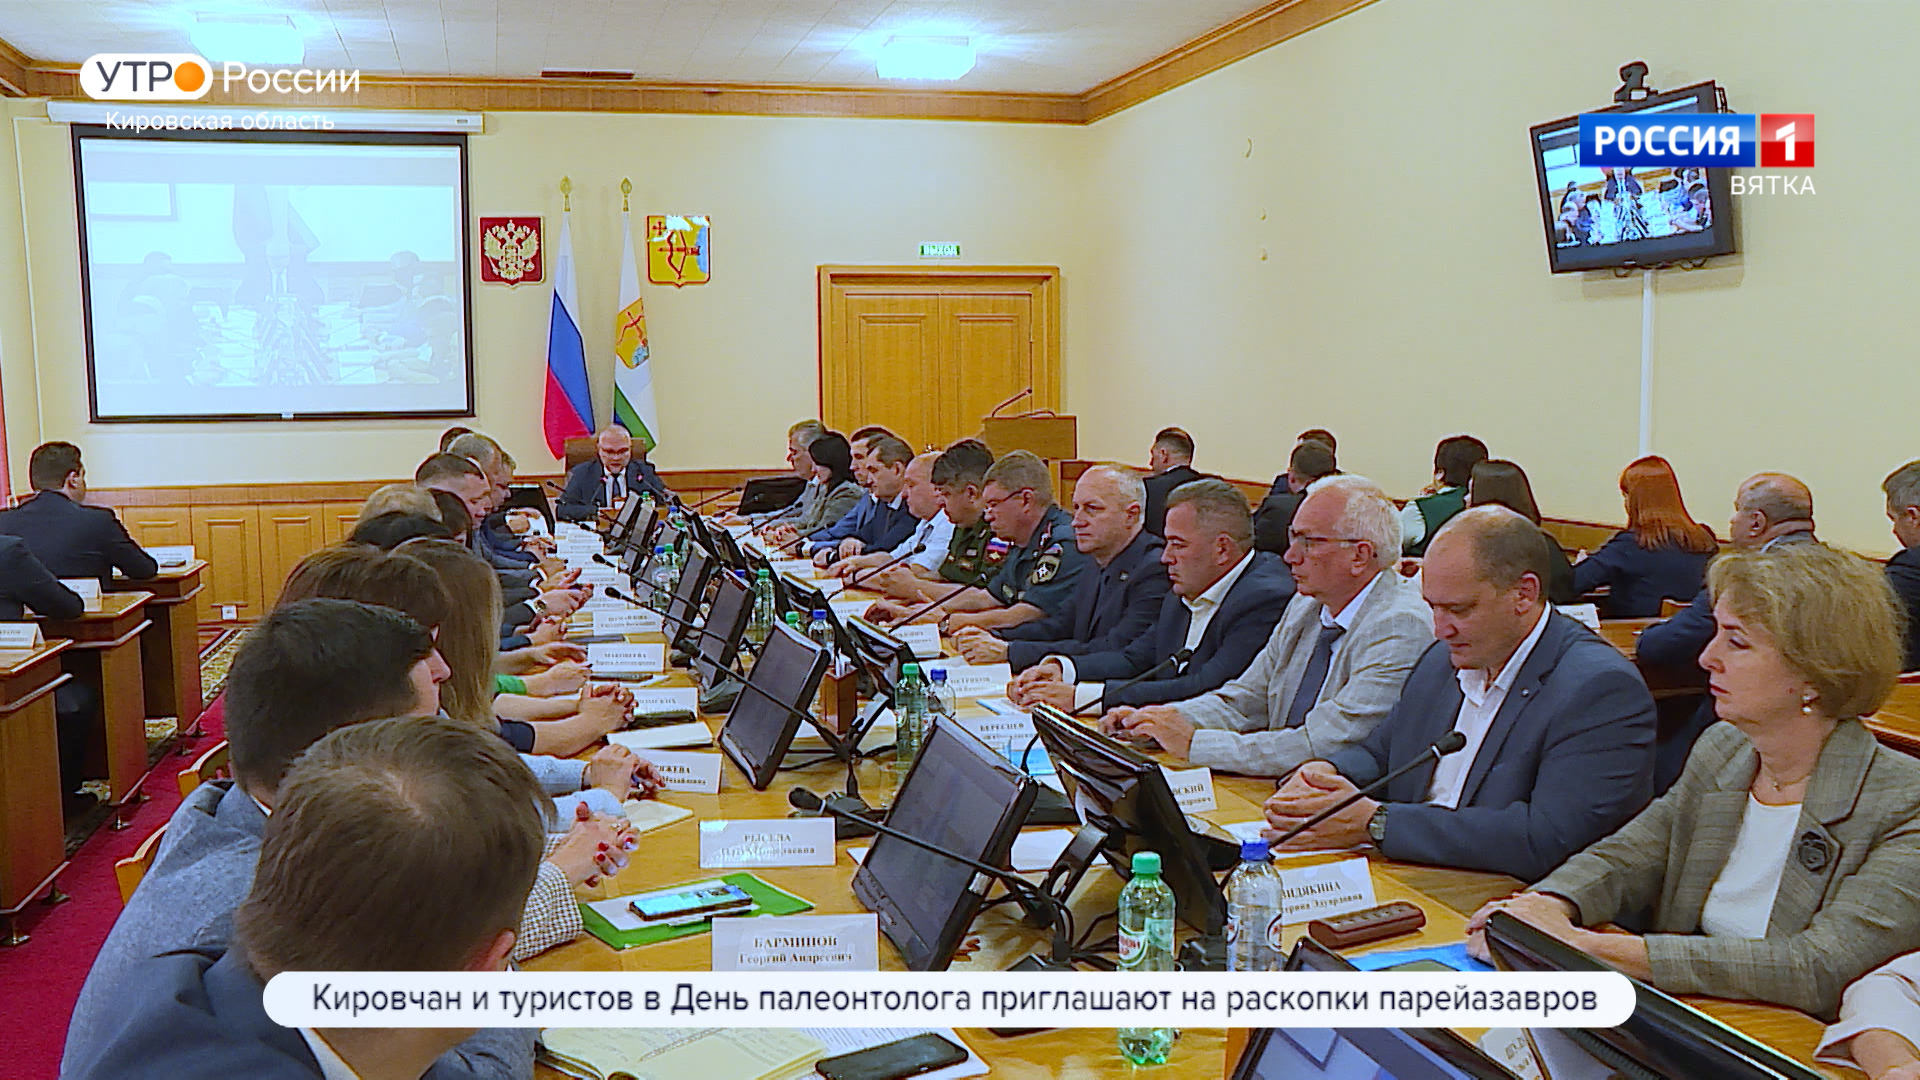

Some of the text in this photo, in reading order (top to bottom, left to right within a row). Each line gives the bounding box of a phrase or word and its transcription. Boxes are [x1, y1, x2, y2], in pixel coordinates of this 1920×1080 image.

[754, 936, 837, 948] БАРМИНОВ
[739, 952, 853, 966] Георгий Андреевич
